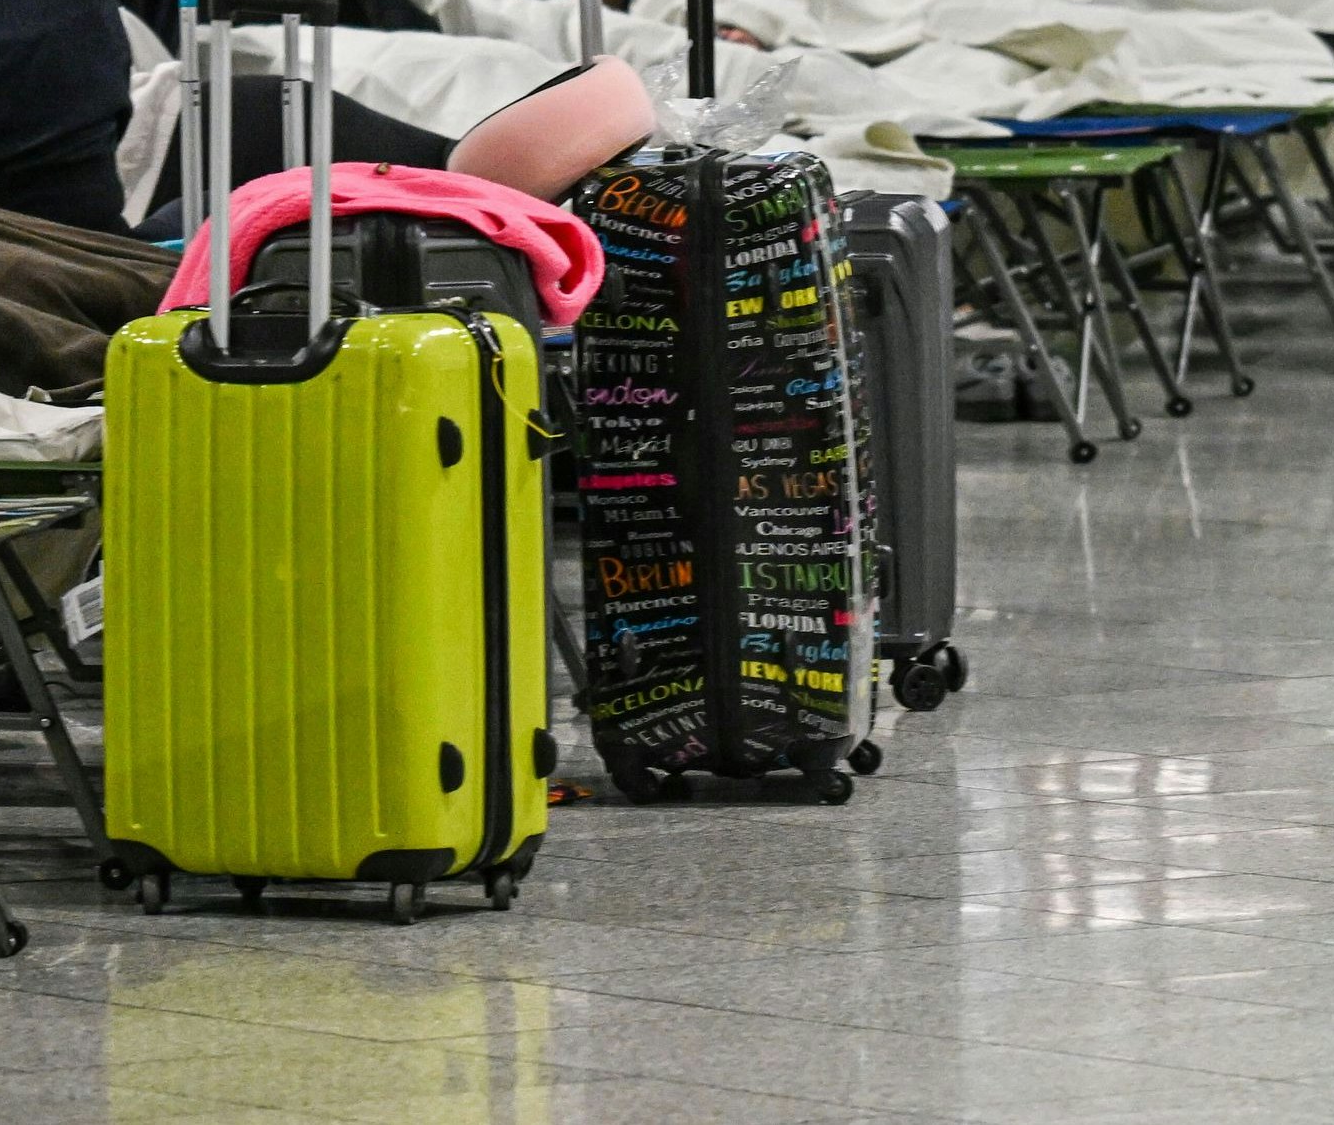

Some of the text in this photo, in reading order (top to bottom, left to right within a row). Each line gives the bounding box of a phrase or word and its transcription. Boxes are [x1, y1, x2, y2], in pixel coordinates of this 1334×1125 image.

[590, 212, 683, 245] Florence
[588, 416, 663, 431] Tokyo
[741, 456, 799, 470] Sydney
[603, 506, 684, 524] Miami
[733, 505, 831, 517] Vancouver
[755, 521, 823, 539] Chicago
[604, 594, 699, 615] Florence
[747, 593, 830, 612] Prague
[794, 667, 844, 693] YORK
